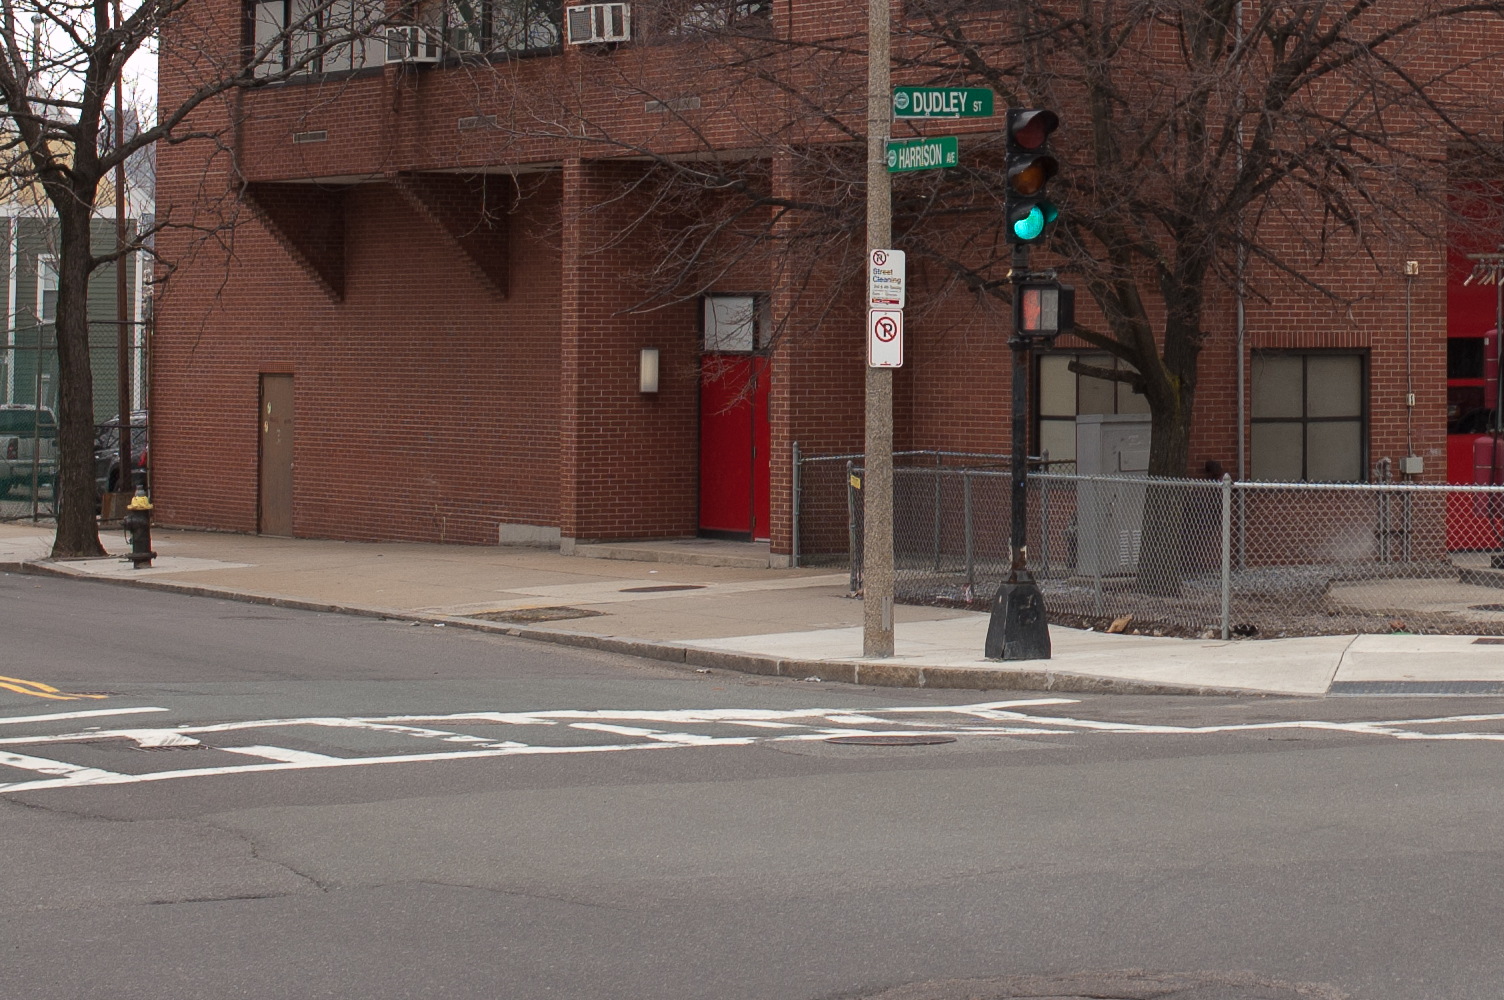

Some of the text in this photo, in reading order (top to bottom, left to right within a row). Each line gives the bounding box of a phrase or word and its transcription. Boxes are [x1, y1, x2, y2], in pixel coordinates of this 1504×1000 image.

[913, 91, 982, 113] DUDLEY ST
[899, 144, 956, 169] HARRISON AVE
[873, 276, 901, 285] Cleaning
